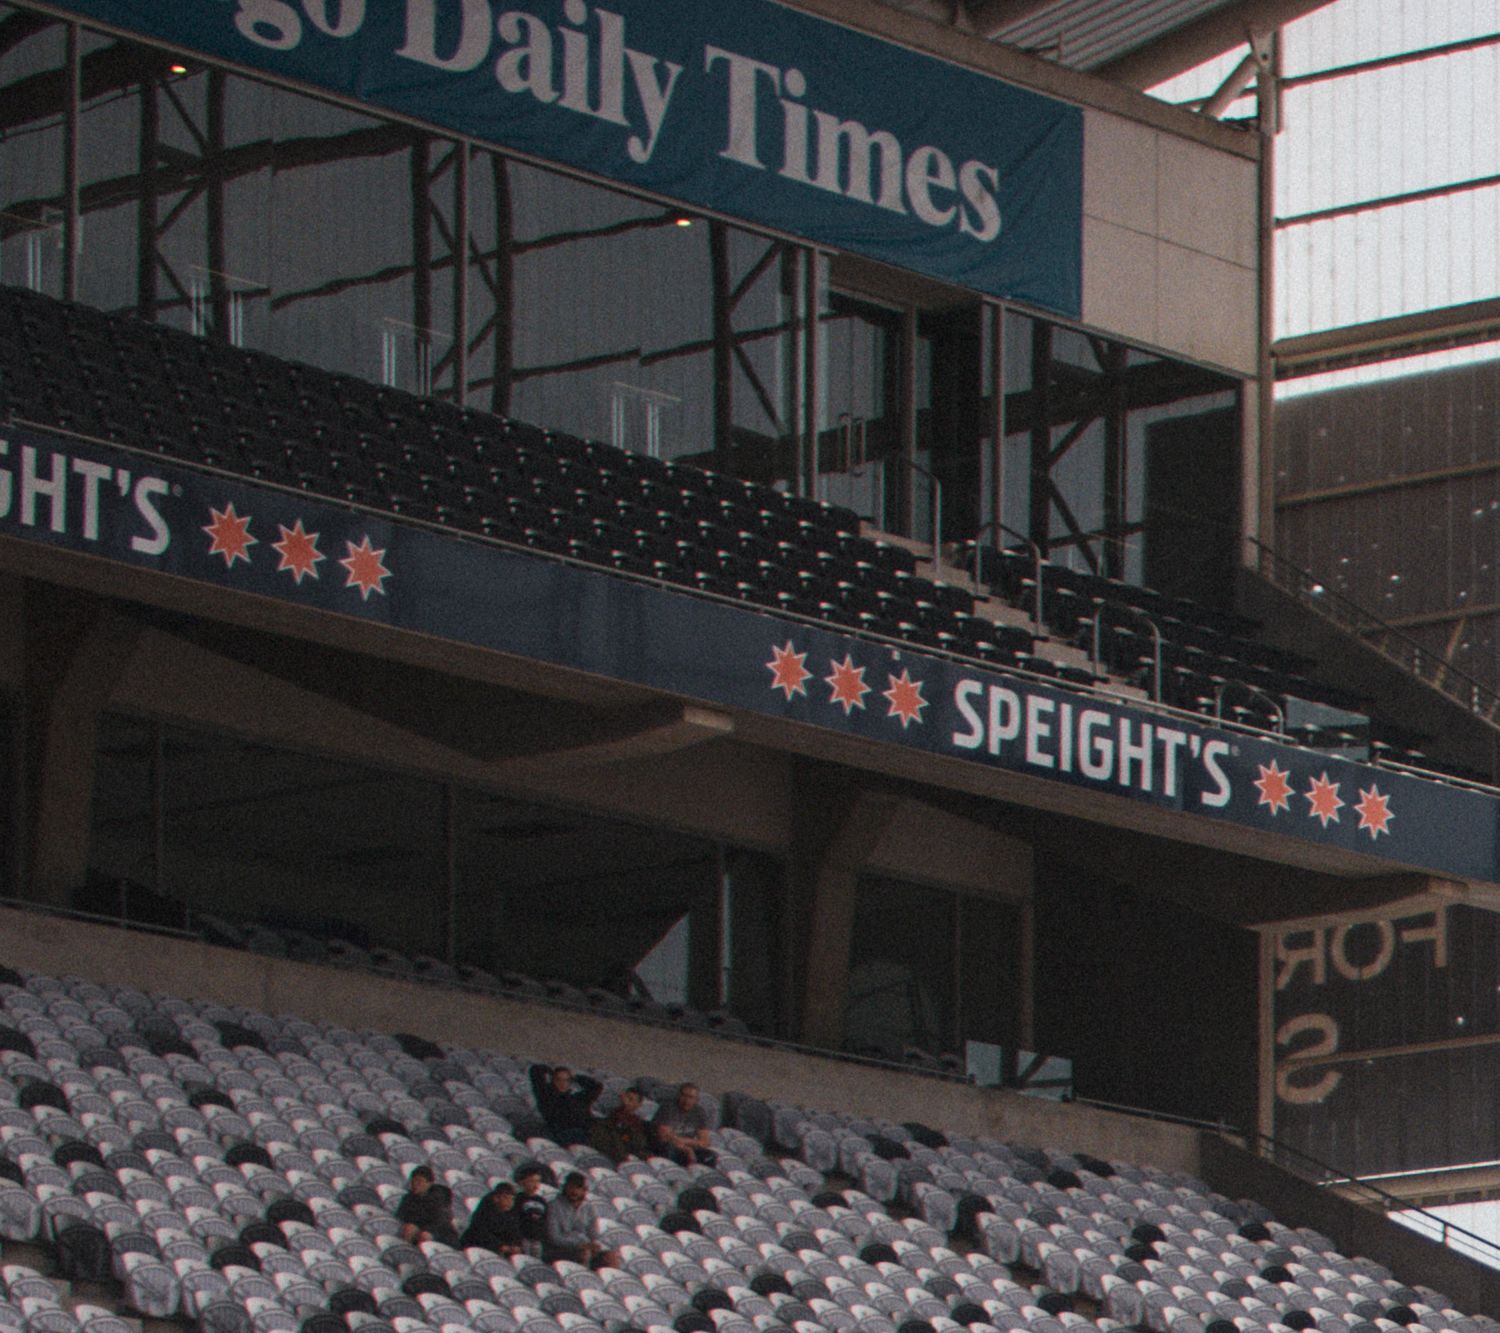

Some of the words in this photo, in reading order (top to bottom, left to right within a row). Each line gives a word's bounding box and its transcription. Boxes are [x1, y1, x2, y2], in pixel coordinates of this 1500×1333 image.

[395, 0, 683, 164] Daily
[705, 45, 1001, 243] Times
[953, 679, 1232, 808] SPEIGHT'S
